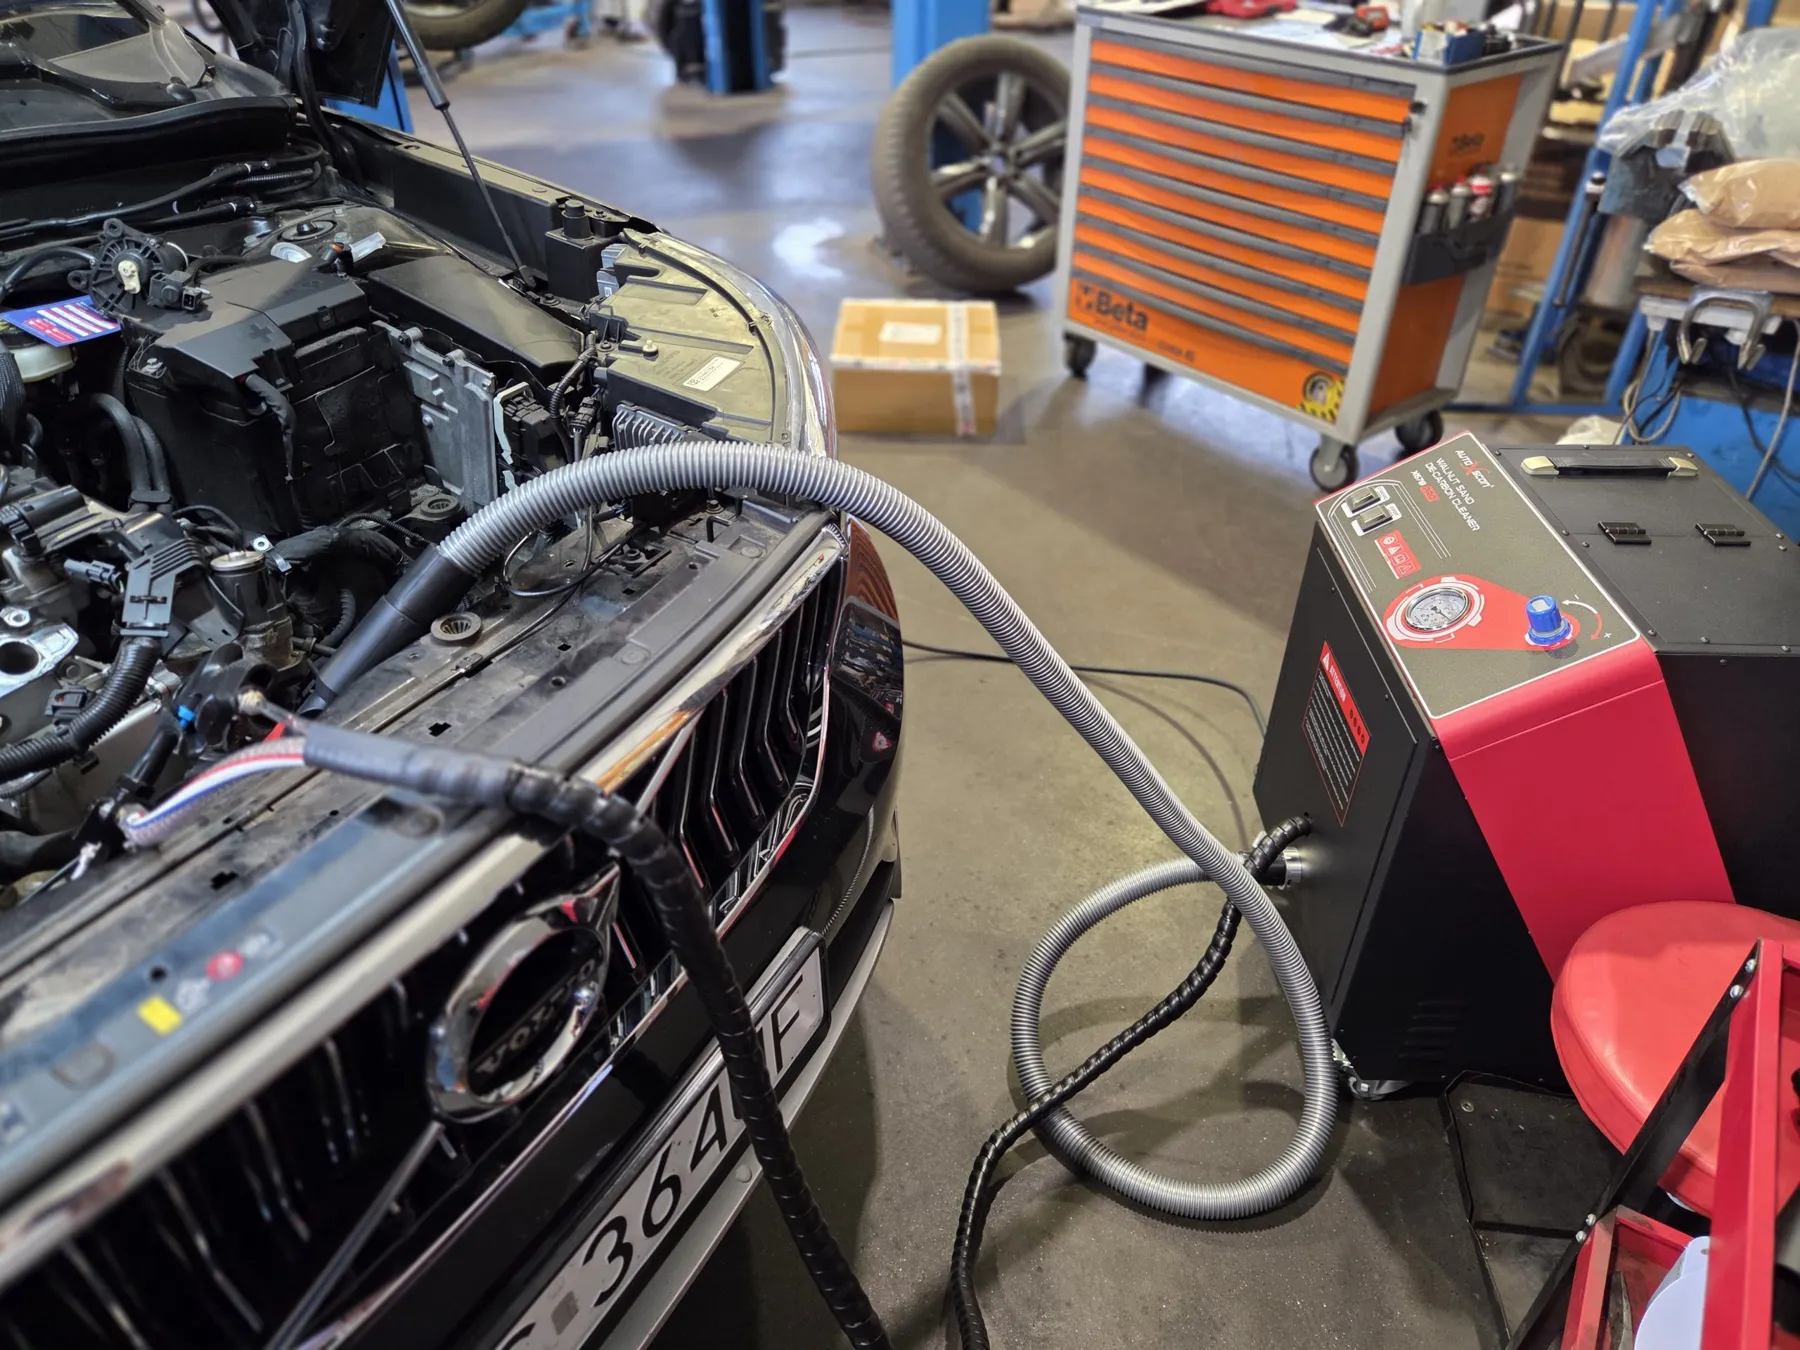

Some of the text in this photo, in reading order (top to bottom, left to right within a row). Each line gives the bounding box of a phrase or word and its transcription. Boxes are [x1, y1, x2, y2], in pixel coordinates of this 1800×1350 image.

[1096, 290, 1149, 332] Beta
[1425, 461, 1480, 532] DE-CARBON CLEANER
[1436, 457, 1475, 505] WALNUT SAND
